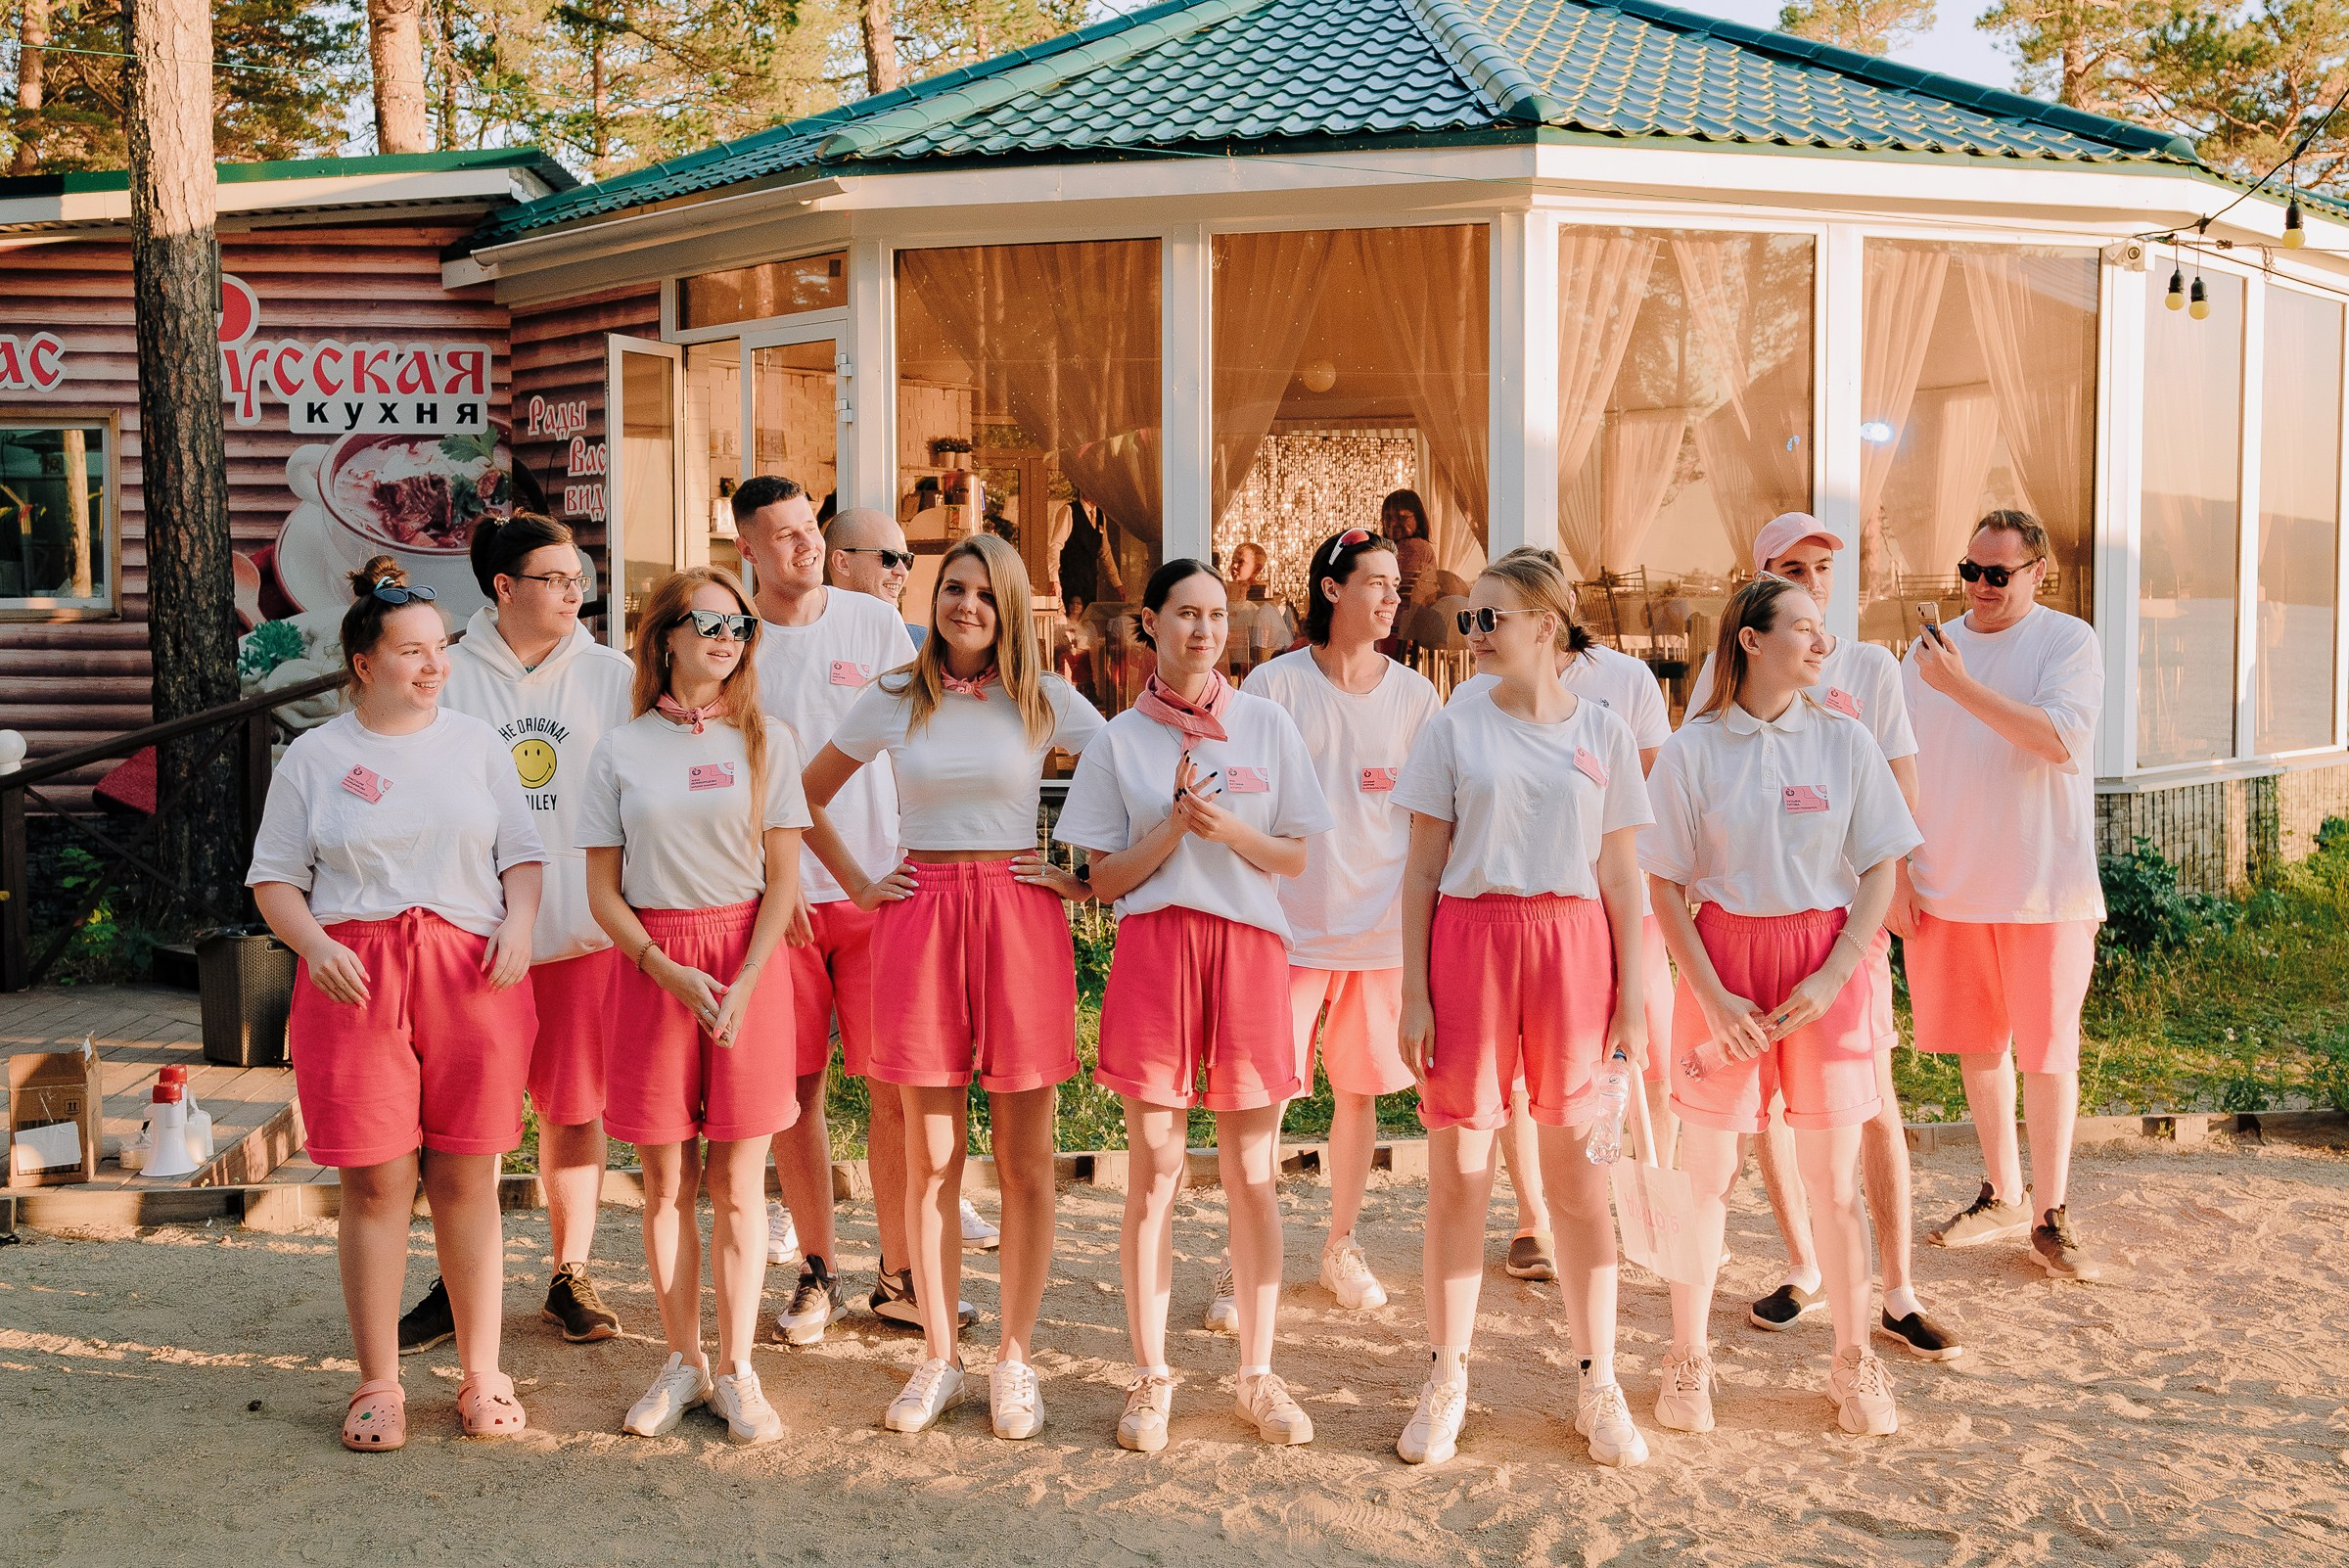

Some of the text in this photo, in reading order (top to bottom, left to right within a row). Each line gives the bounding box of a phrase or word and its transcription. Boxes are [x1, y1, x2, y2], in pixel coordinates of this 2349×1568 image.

[306, 401, 480, 431] кухня
[529, 397, 586, 438] Рады
[569, 438, 606, 474] Вас
[565, 487, 606, 517] вид
[497, 716, 570, 744] HE ORIGINAL
[526, 794, 557, 810] ILEY
